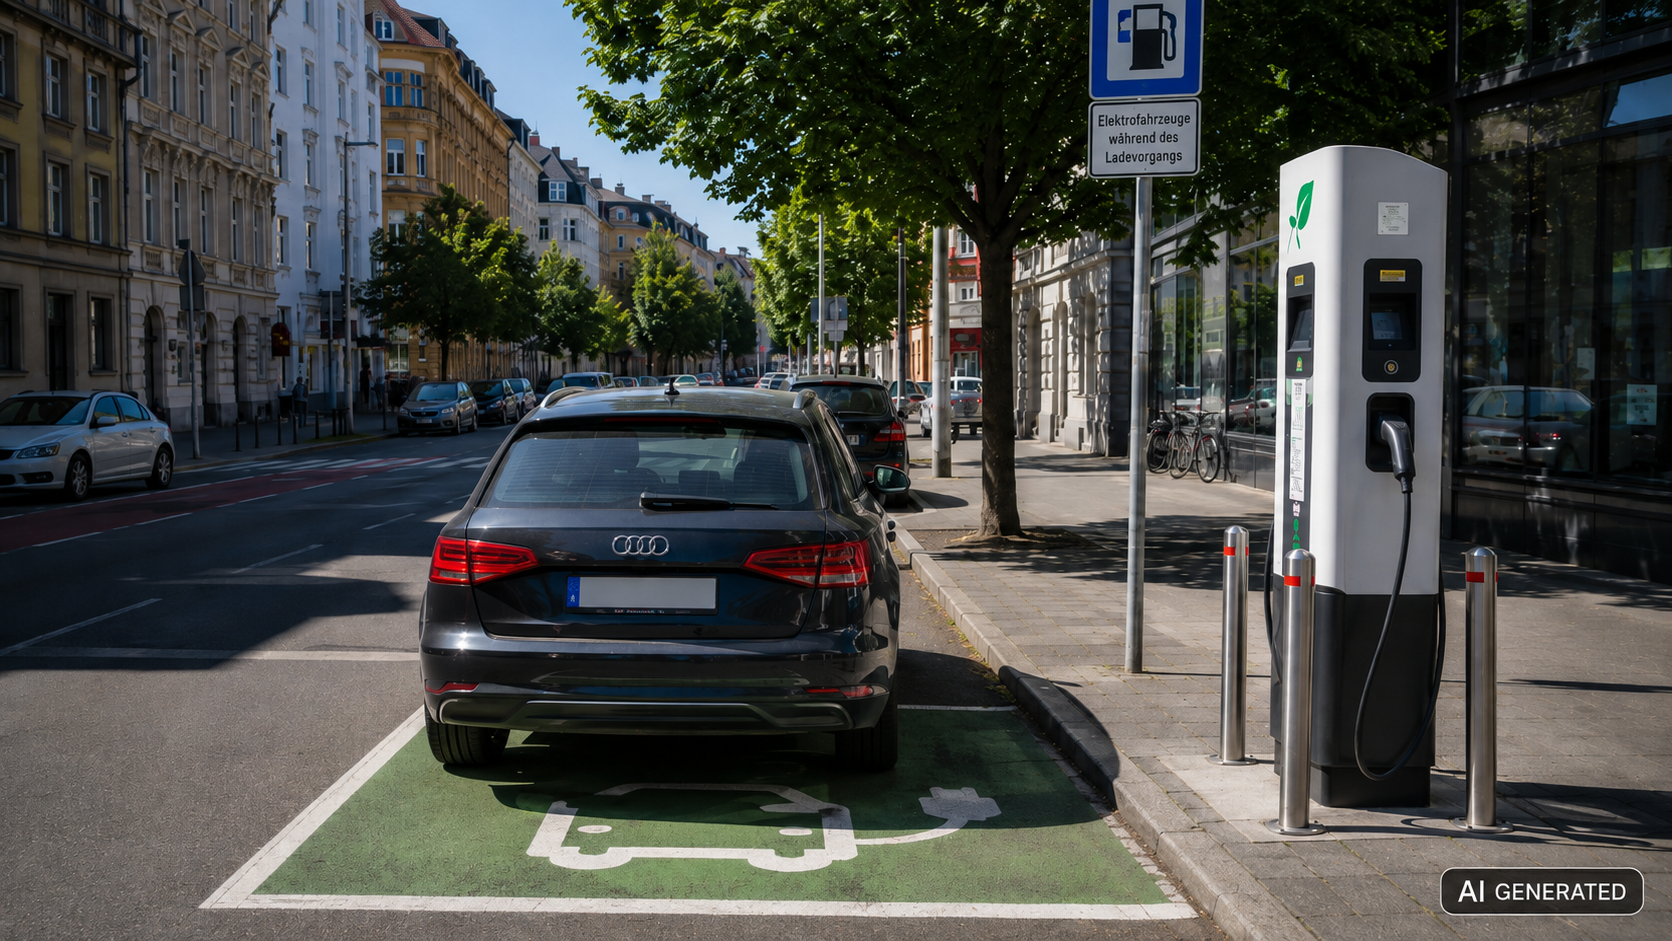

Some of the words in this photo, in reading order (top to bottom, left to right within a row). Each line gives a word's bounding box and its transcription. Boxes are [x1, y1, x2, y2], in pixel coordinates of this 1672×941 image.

[1098, 113, 1191, 127] Elektrofahrzeuge
[1109, 131, 1156, 144] während
[1159, 131, 1179, 143] des
[1105, 151, 1183, 165] Ladevorgangs
